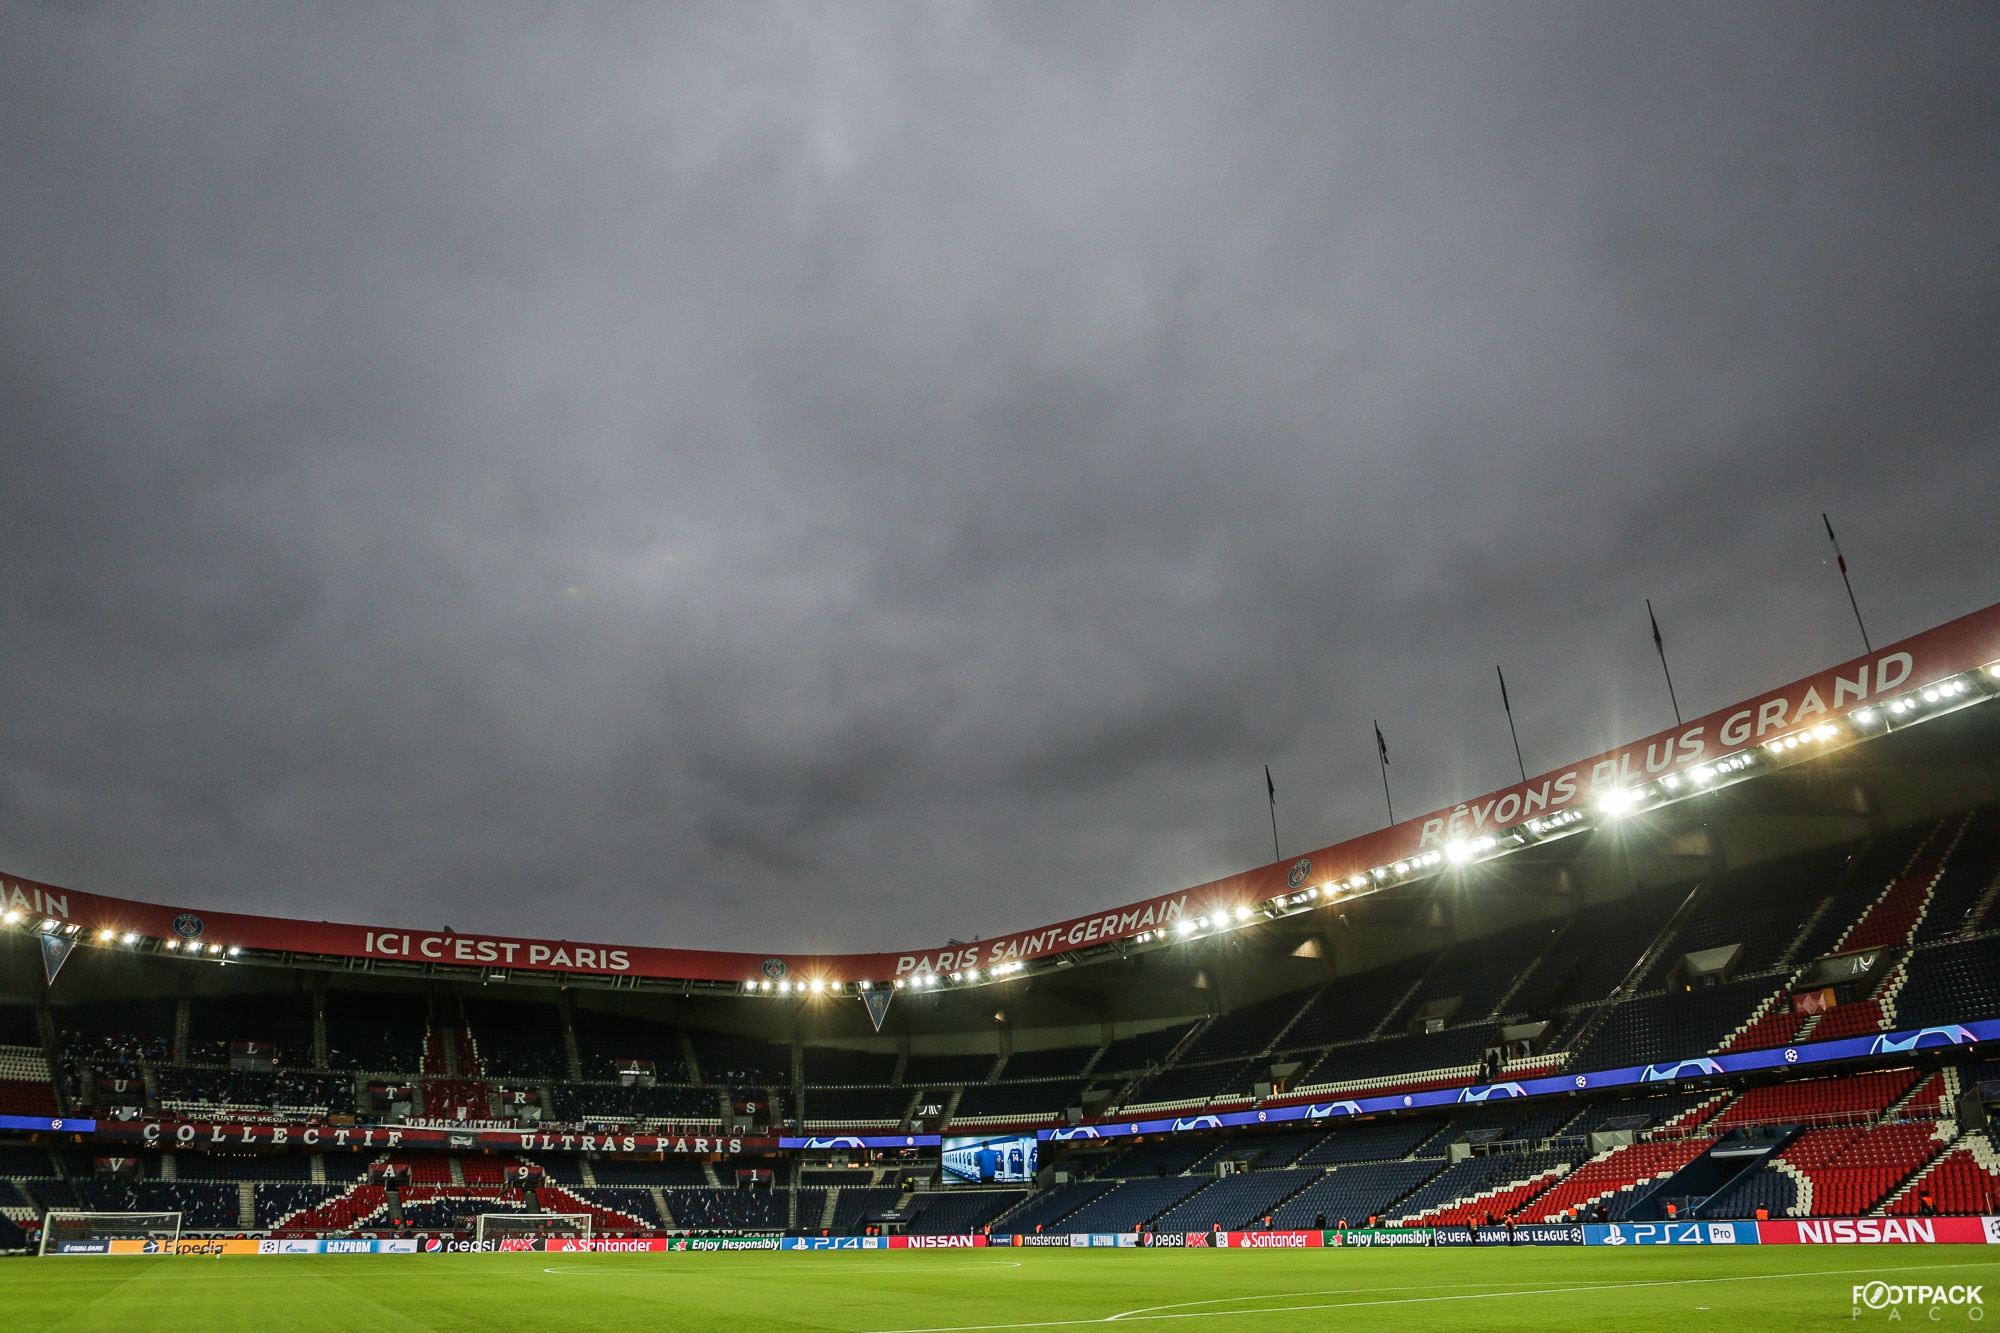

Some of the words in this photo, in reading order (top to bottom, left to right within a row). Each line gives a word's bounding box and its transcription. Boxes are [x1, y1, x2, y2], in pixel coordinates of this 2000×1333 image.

[1419, 772, 1577, 848] RÊVONS
[1590, 726, 1705, 795] PLUS
[1720, 651, 1914, 746] GRAND
[895, 946, 980, 976] PARIS
[987, 895, 1188, 964] SAINT-GERMAIN
[365, 932, 409, 955] ICI
[420, 937, 520, 963] C'EST
[529, 945, 631, 971] PARIS
[246, 1042, 257, 1054] L
[630, 1060, 640, 1070] A
[114, 1079, 129, 1092] U
[386, 1087, 397, 1099] T
[513, 1092, 526, 1104] R
[746, 1102, 756, 1113] S
[144, 1124, 402, 1147] COLLECTIF
[520, 1135, 636, 1152] ULTRAS
[656, 1137, 742, 1153] PARIS
[1012, 1153, 1019, 1162] 14
[110, 1157, 124, 1172] V
[382, 1164, 396, 1177] A
[518, 1167, 529, 1179] 9
[1447, 1232, 1472, 1242] UEFA
[1532, 1230, 1569, 1242] LEAGUE
[1633, 1224, 1704, 1244] PS4
[1713, 1228, 1731, 1239] Pro
[1797, 1219, 1936, 1244] NISSAN
[578, 1239, 652, 1251] Santander
[692, 1239, 720, 1251] Enjoy
[722, 1238, 780, 1250] Responsibly
[814, 1237, 859, 1250] PS4
[908, 1236, 973, 1248] NISSAN
[1024, 1234, 1068, 1246] mastercard
[1155, 1233, 1183, 1248] pepsi
[1186, 1232, 1209, 1247] MAX
[1251, 1232, 1307, 1248] Santander
[1347, 1231, 1372, 1247] Enjoy
[1374, 1230, 1431, 1247] Responsibly
[164, 1240, 224, 1254] Expedia
[326, 1241, 371, 1253] GAZPROM
[447, 1239, 495, 1253] pepsi
[499, 1239, 538, 1252] MAX
